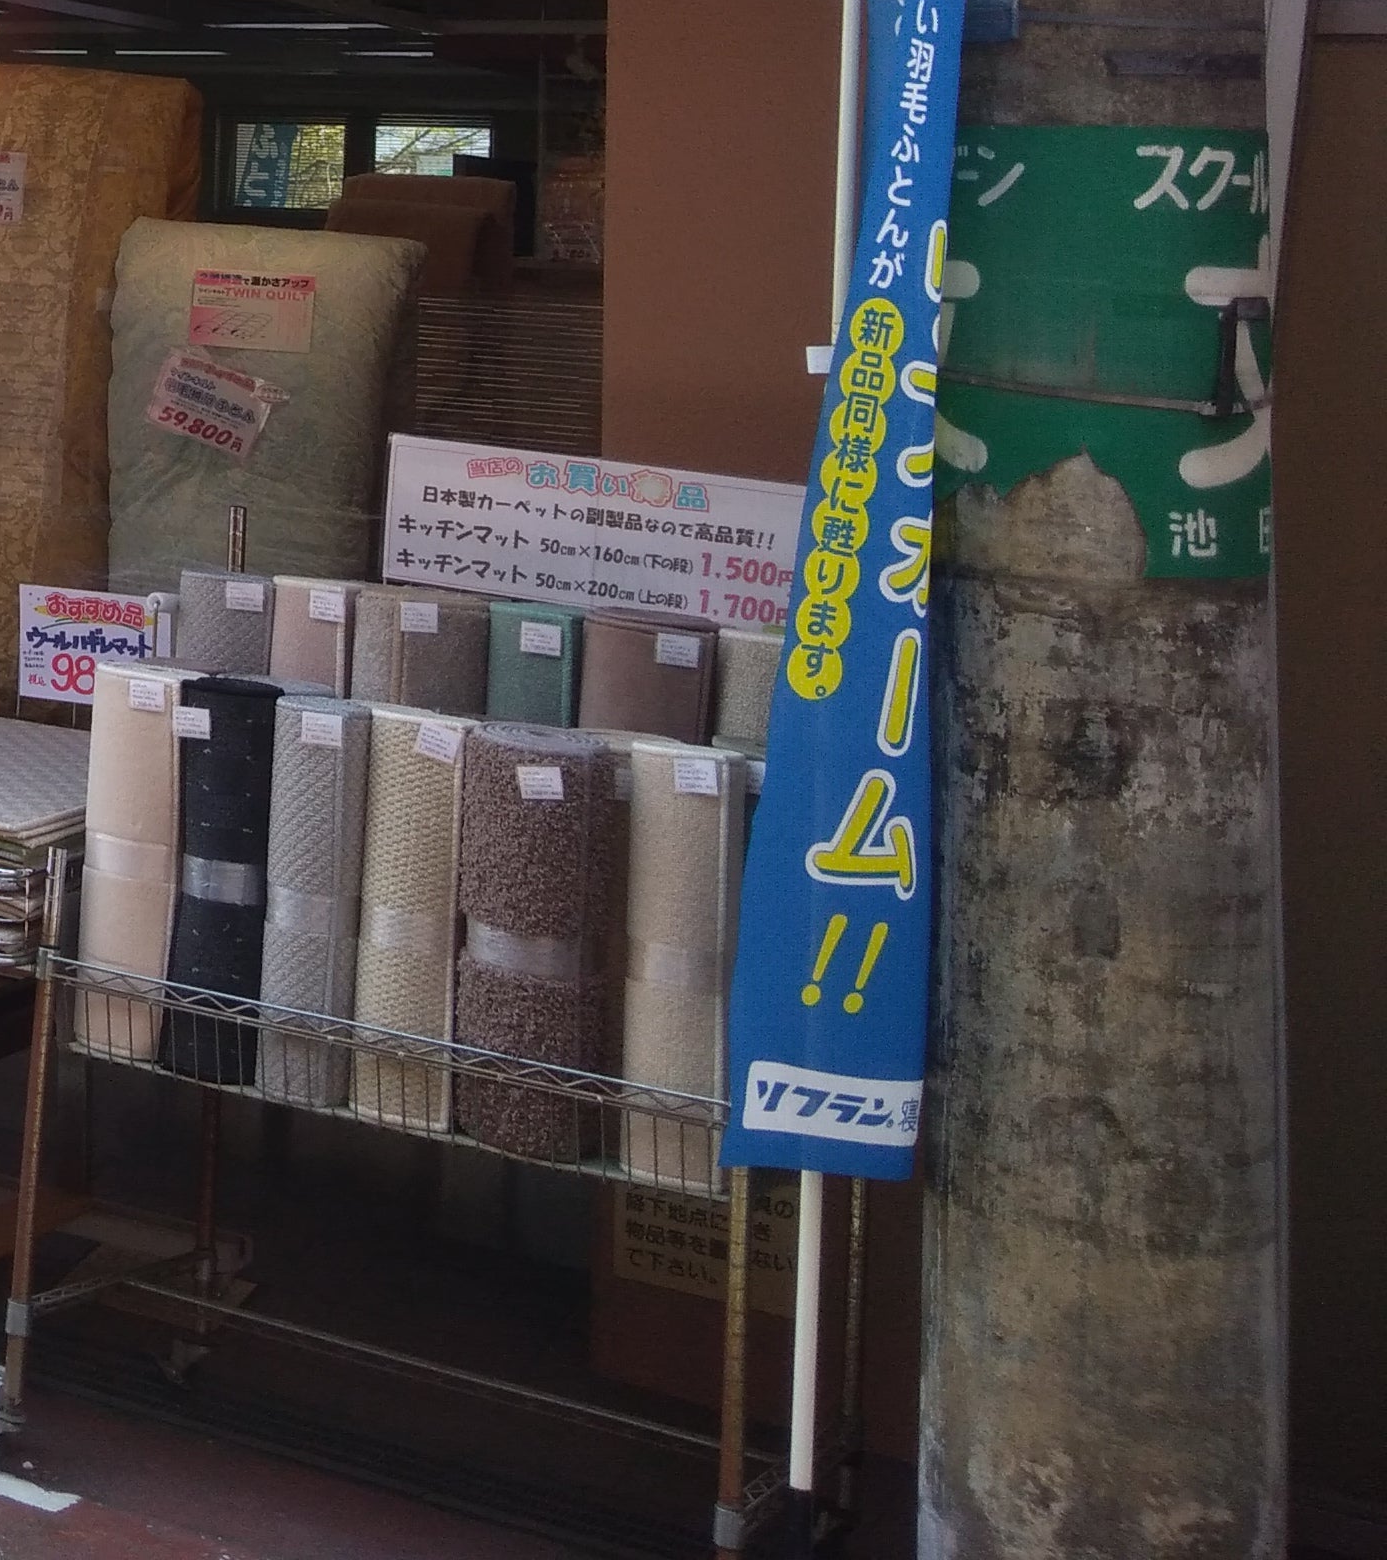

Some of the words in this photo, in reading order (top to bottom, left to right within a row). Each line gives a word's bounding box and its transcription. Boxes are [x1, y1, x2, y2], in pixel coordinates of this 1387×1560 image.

[225, 287, 261, 300] TWIN
[265, 289, 310, 302] QUILT
[397, 513, 531, 550] キッチンマット
[395, 547, 529, 585] キッチンマット
[45, 591, 146, 630] おすすめ品
